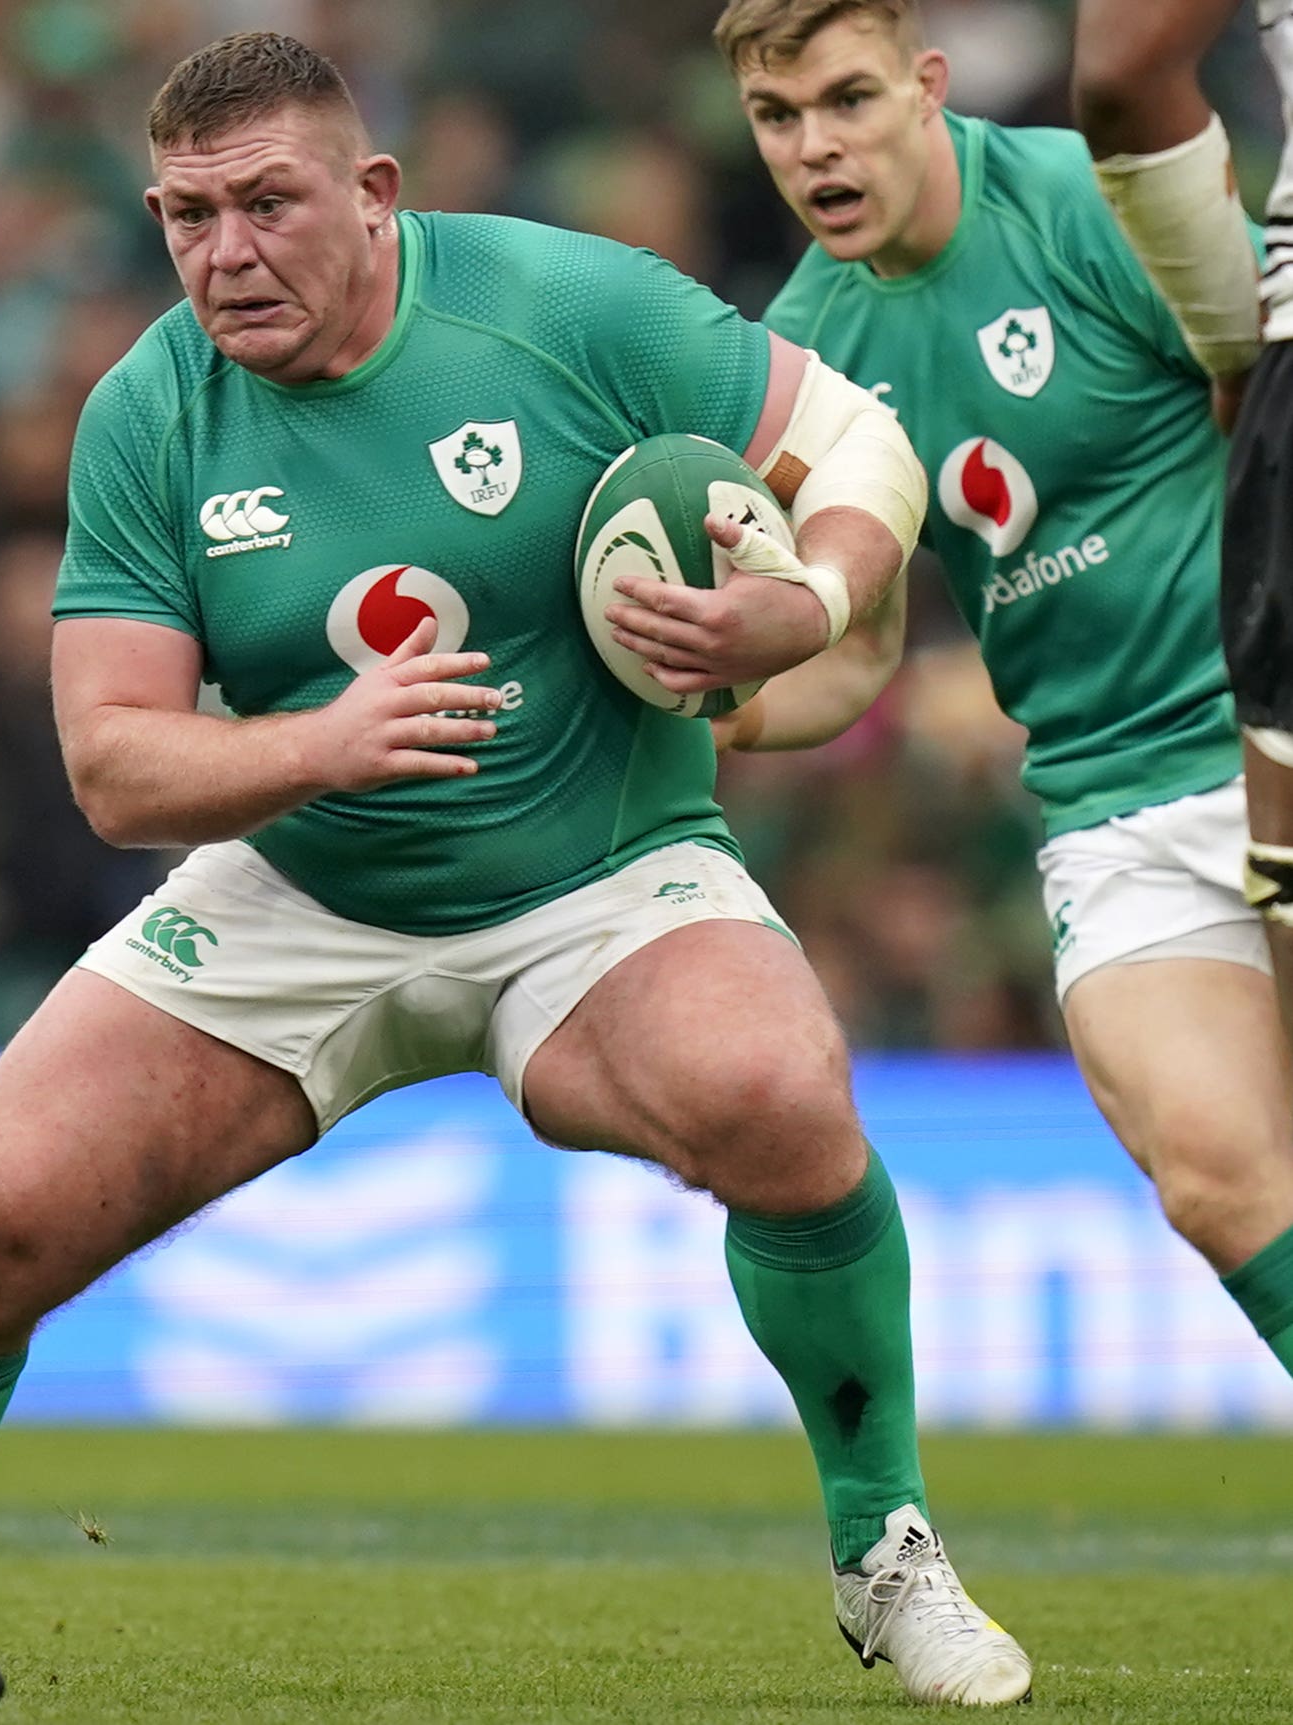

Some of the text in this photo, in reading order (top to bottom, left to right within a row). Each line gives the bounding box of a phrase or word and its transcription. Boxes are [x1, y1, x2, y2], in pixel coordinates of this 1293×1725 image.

[470, 481, 508, 504] IRFU
[206, 532, 293, 558] canterbury
[981, 533, 1110, 614] dafone
[125, 938, 194, 984] canterbury
